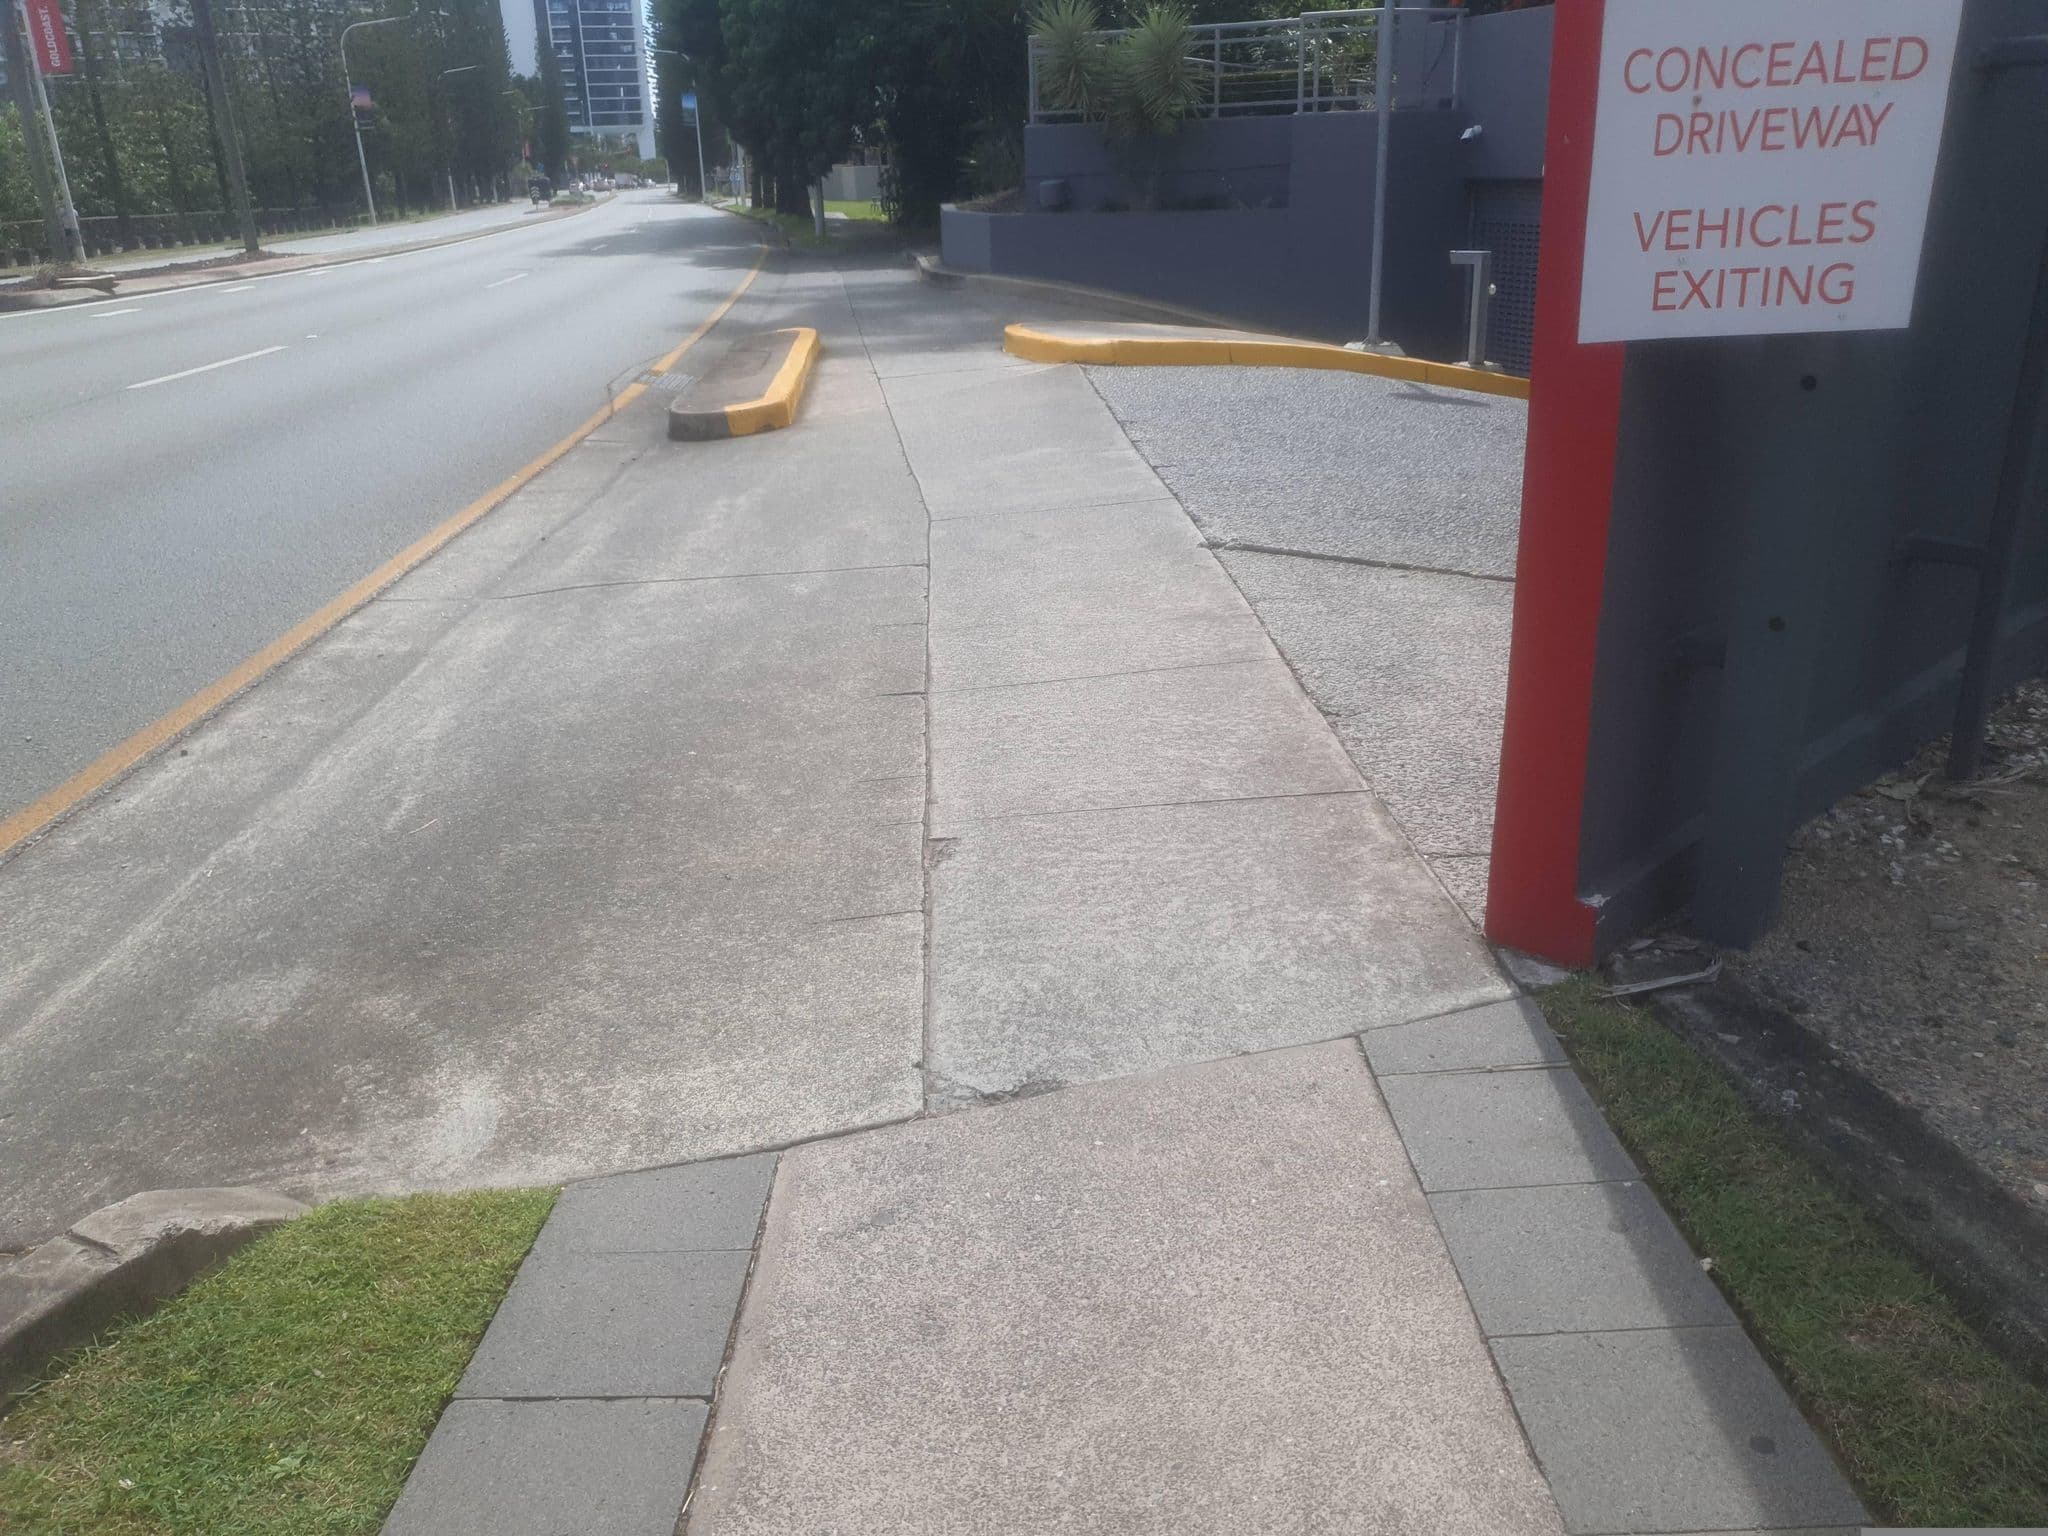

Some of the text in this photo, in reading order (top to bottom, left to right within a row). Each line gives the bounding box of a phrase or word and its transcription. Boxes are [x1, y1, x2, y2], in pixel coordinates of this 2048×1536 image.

[1623, 36, 1930, 94] CONCEALED
[1653, 102, 1895, 156] DRIVEWAY
[1633, 200, 1879, 252] VEHICLES
[1651, 262, 1855, 312] EXITING
